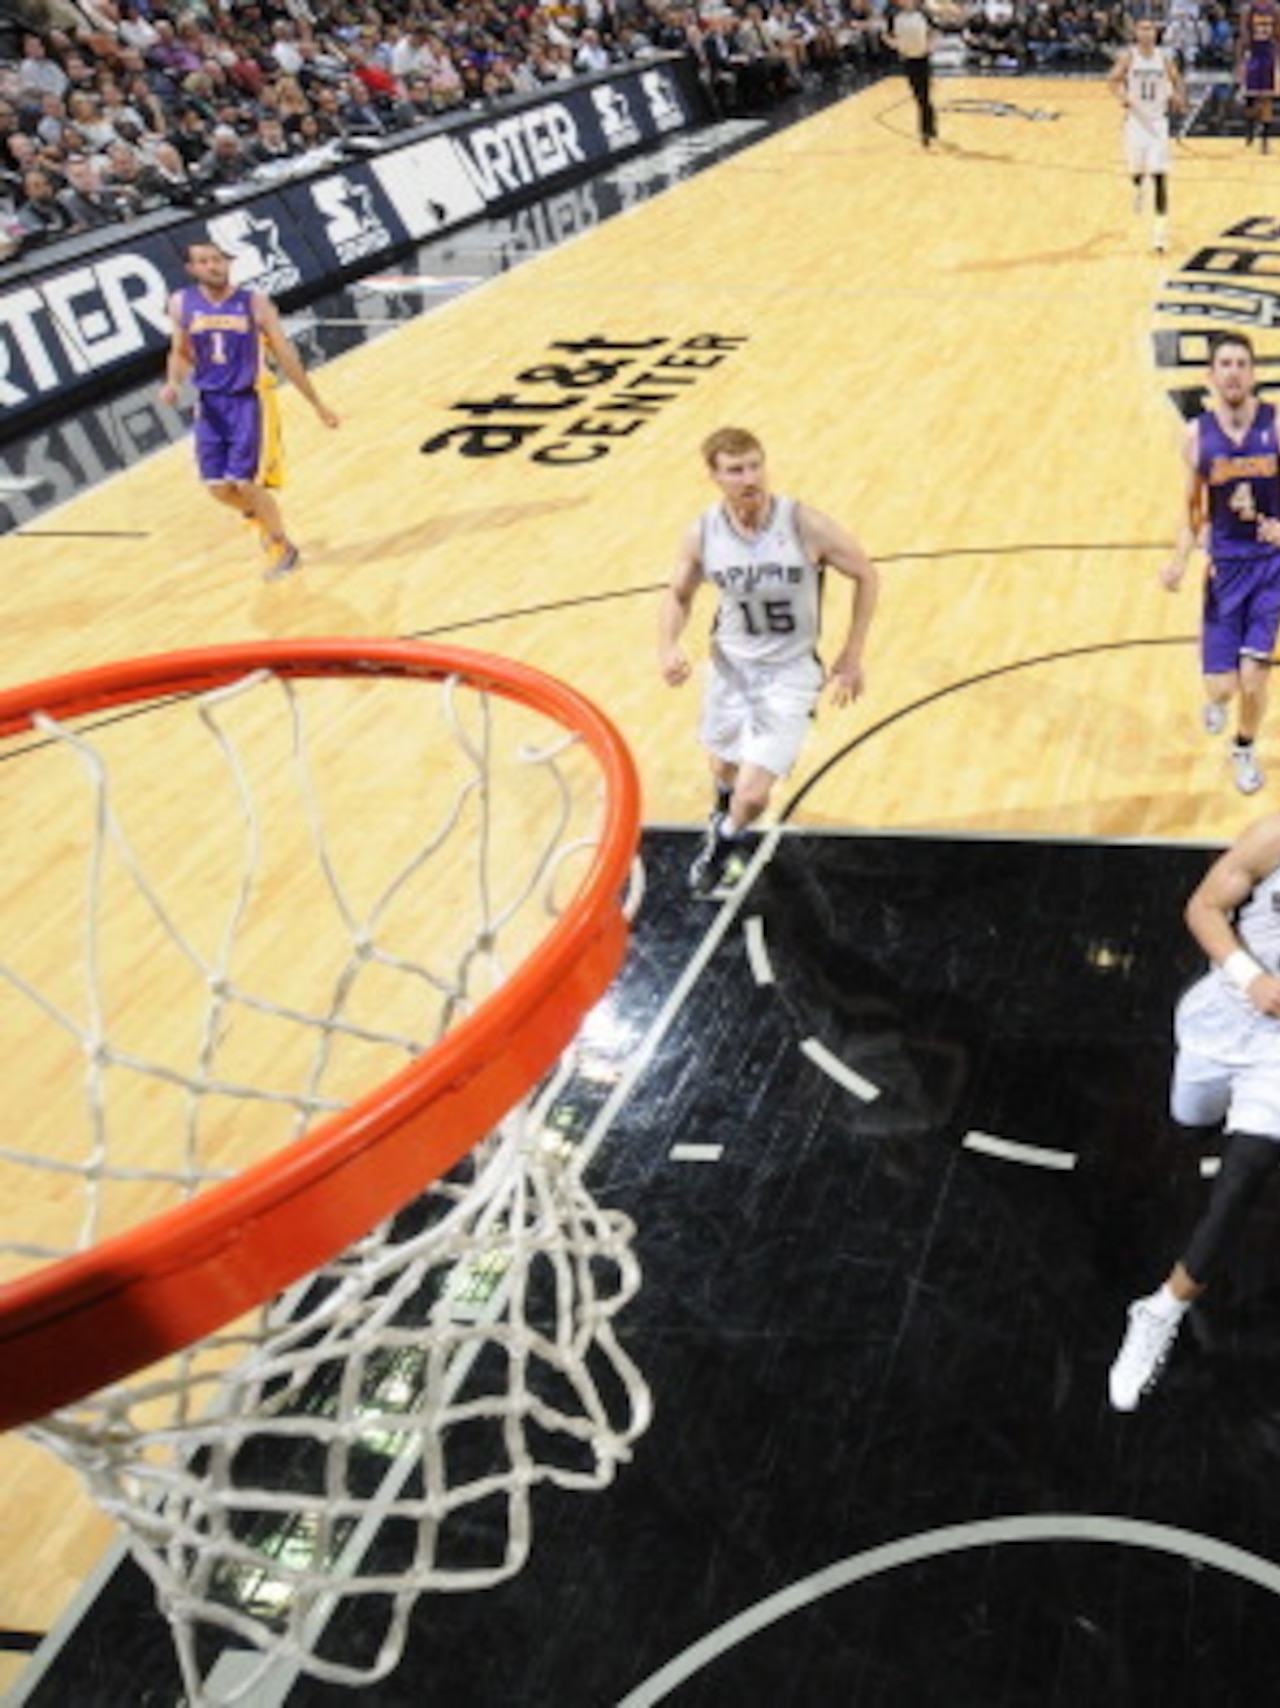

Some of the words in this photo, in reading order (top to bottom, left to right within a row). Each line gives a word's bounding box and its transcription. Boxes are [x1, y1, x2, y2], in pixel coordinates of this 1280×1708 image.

[210, 331, 227, 365] 1
[420, 335, 672, 457] at&t
[530, 334, 748, 466] CENTER
[1228, 482, 1258, 522] 4
[738, 599, 796, 637] 15
